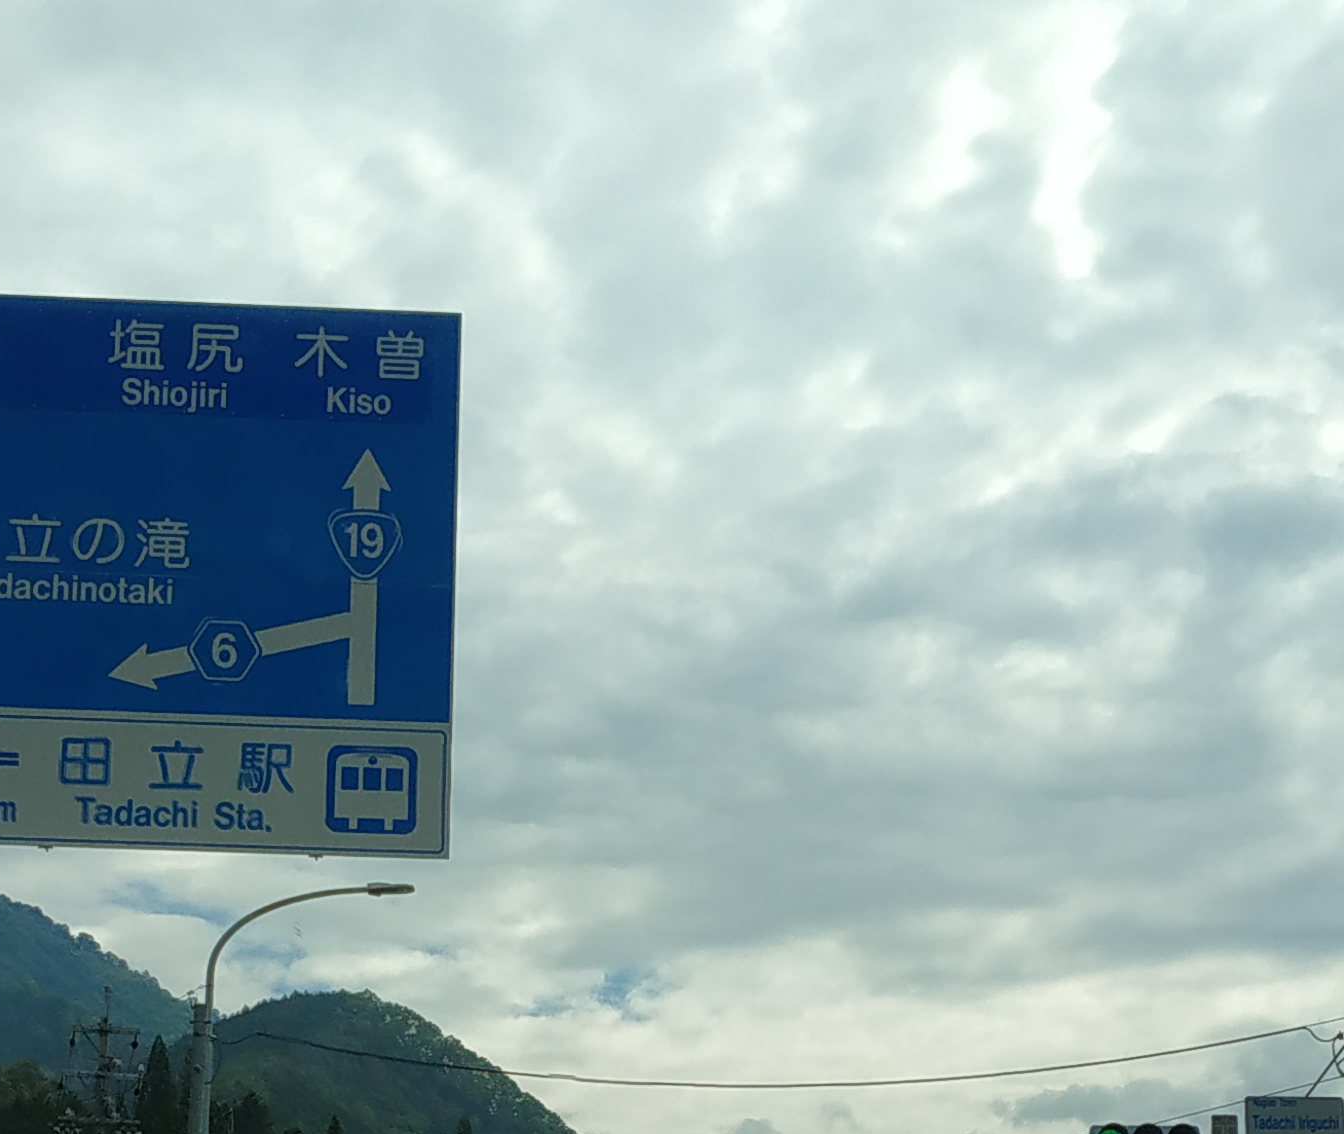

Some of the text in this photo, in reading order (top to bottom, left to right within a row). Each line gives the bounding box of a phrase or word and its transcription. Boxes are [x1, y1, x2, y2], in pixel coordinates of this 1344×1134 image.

[108, 319, 424, 380] 塩尻 木曽
[121, 378, 391, 415] Shiojiri Kiso
[346, 523, 383, 560] 19
[211, 632, 237, 667] 6
[59, 737, 293, 794] 田立駅
[75, 797, 272, 832] Tadachi Sta.
[1252, 1115, 1339, 1133] Tadachi Iriguchi
